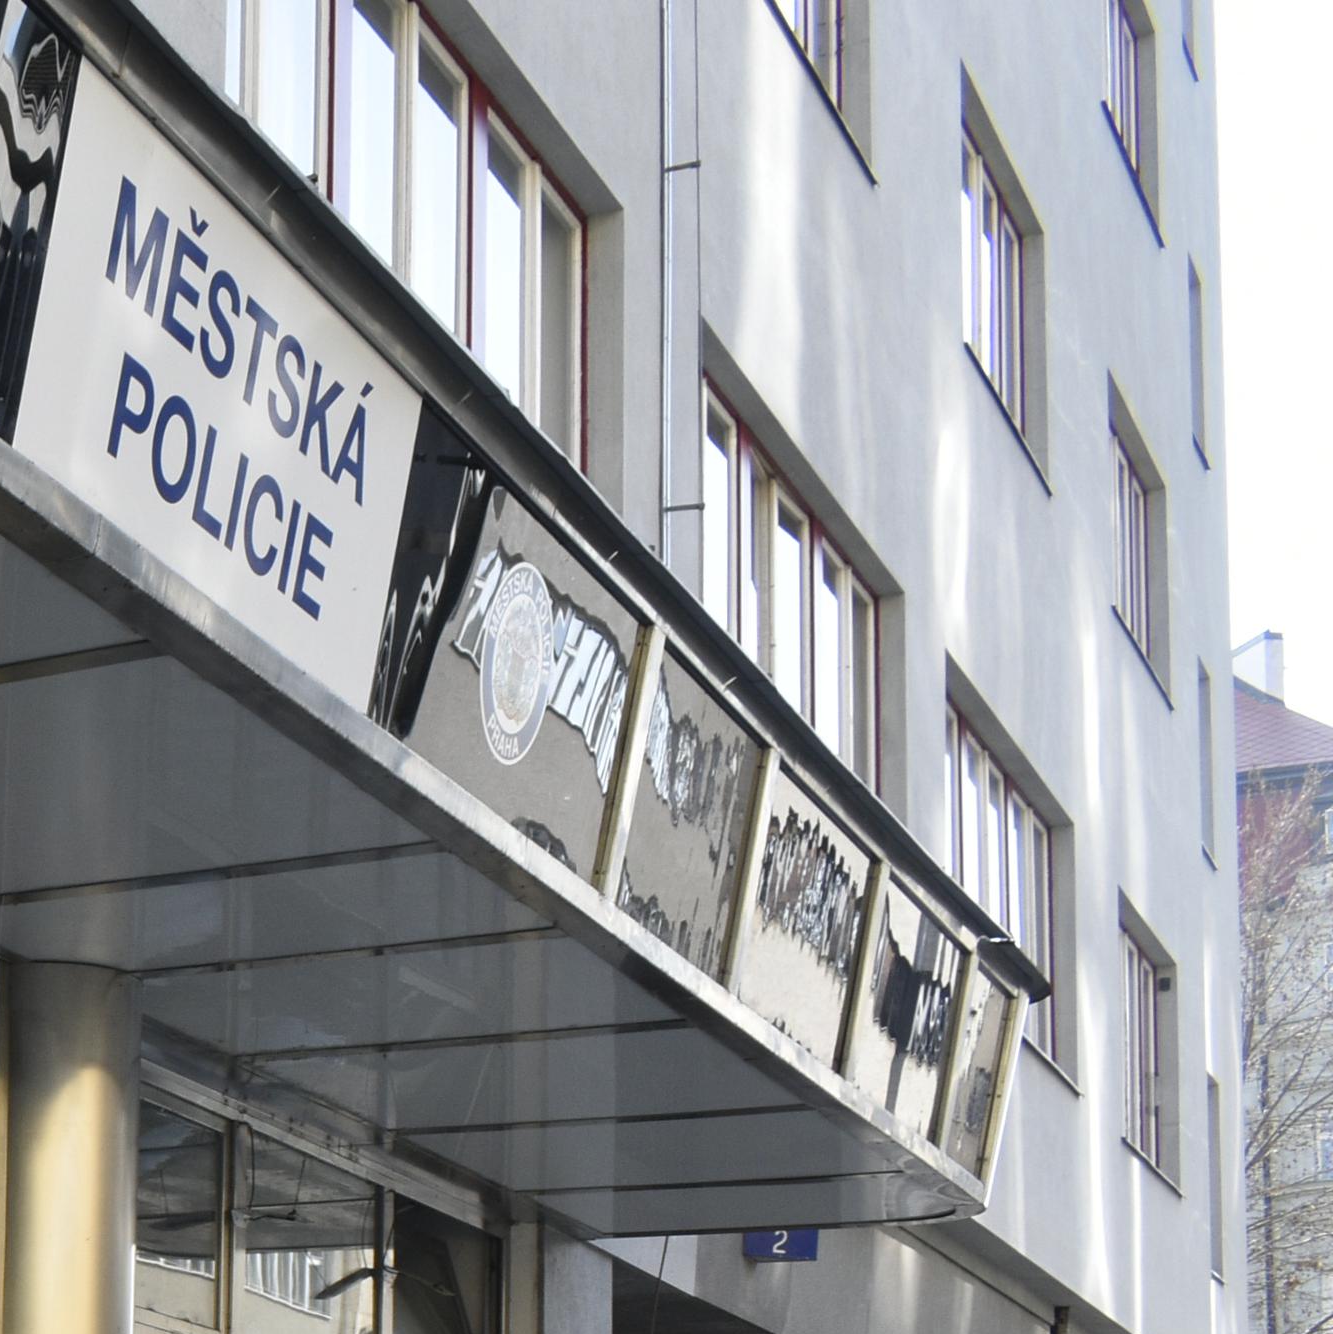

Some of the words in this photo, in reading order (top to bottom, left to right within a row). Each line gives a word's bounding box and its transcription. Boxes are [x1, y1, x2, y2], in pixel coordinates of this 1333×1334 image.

[104, 174, 374, 507] MĚSTSKÁ
[106, 352, 333, 621] POLICIE
[487, 713, 520, 759] PRAHA
[772, 1230, 788, 1254] 2
